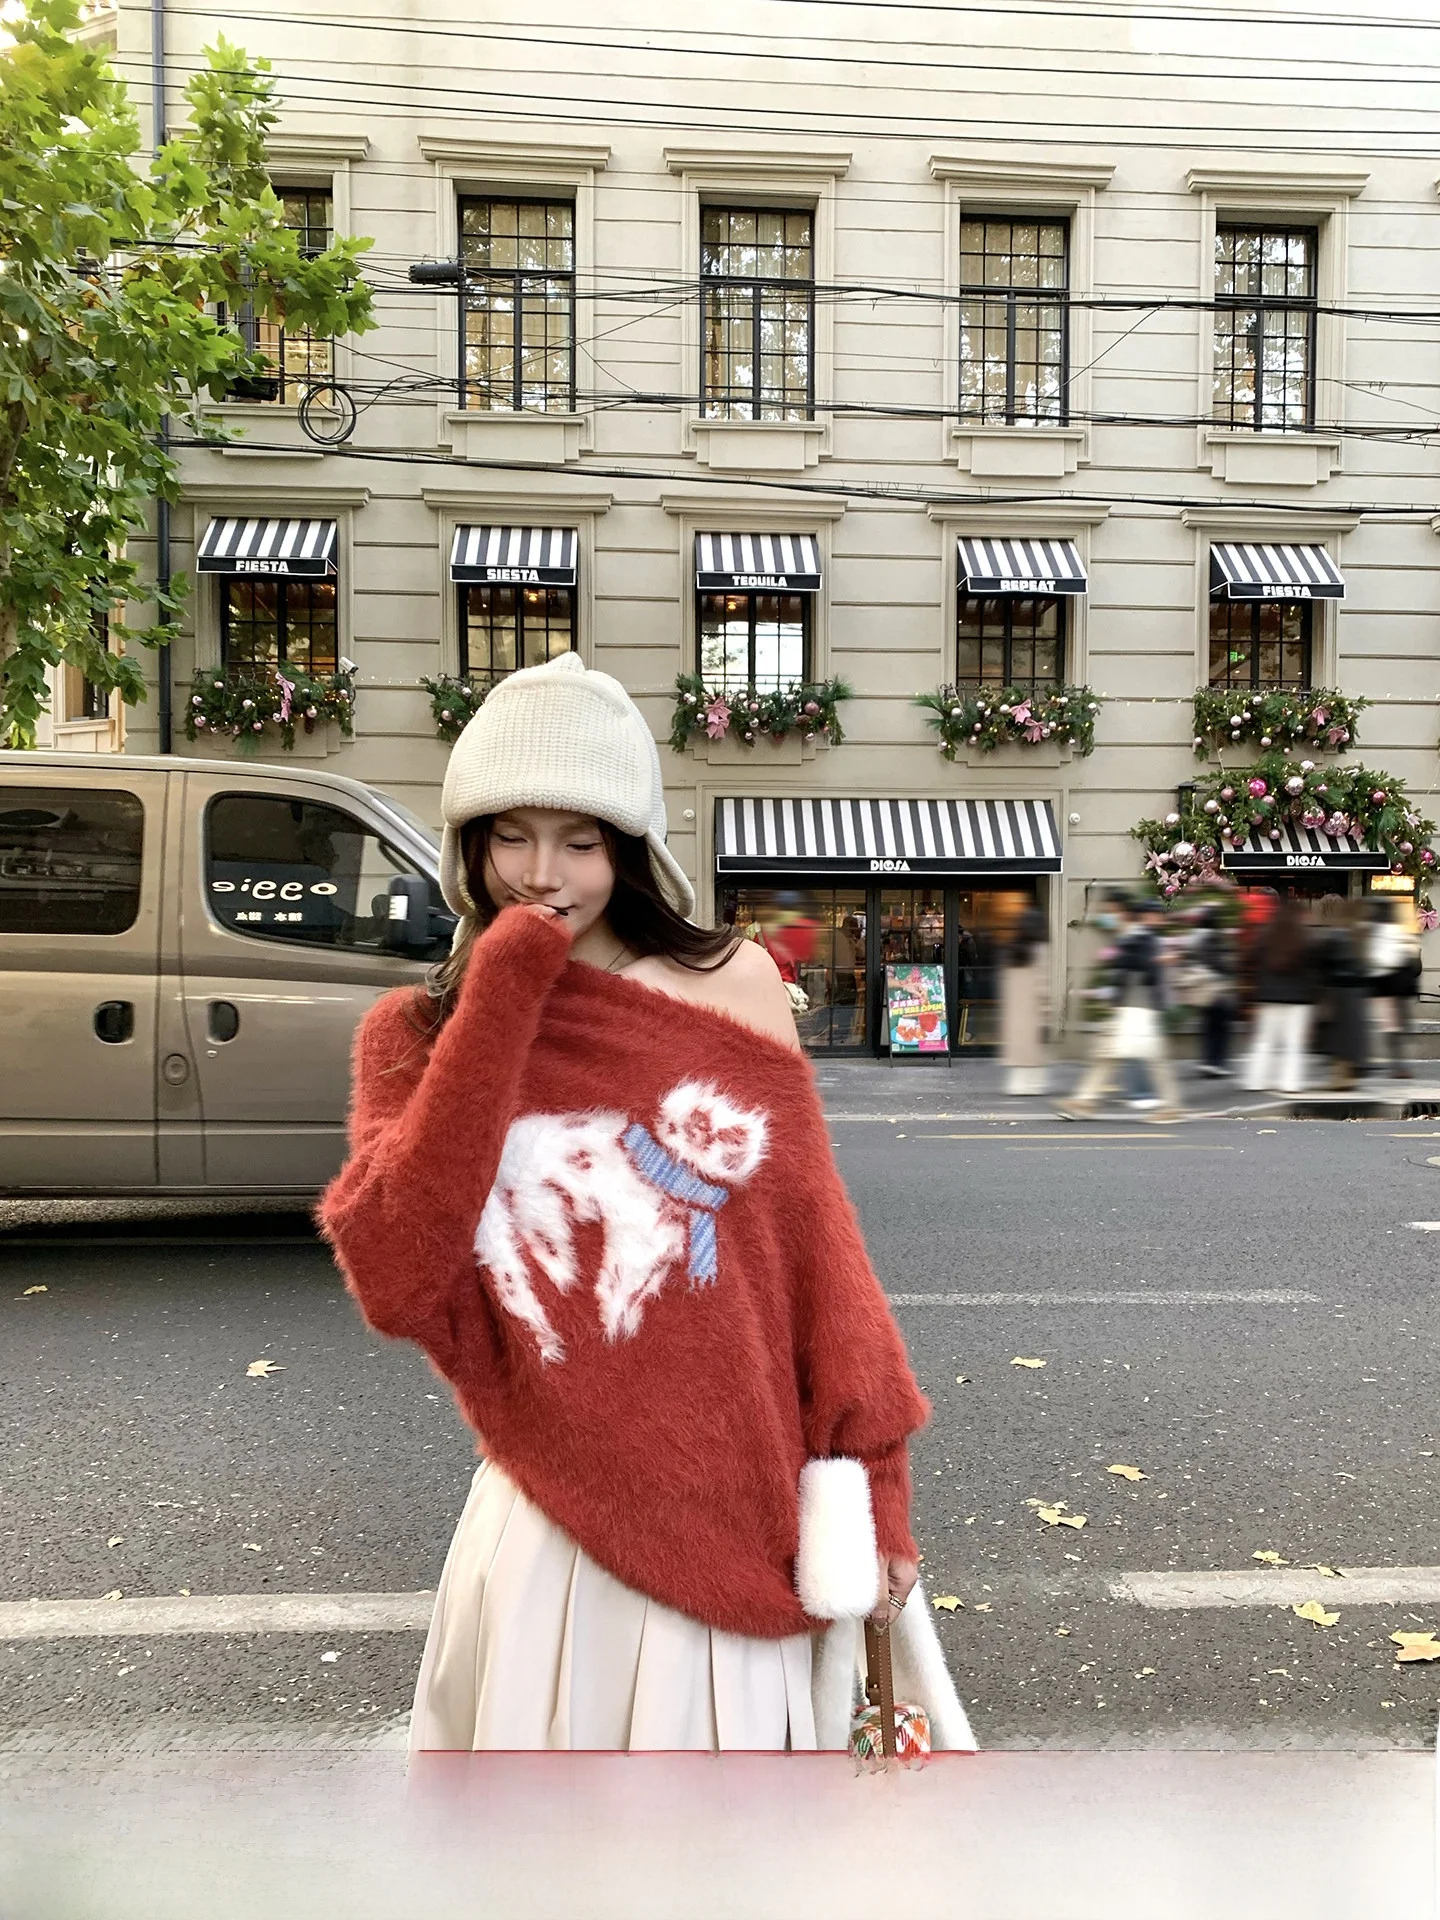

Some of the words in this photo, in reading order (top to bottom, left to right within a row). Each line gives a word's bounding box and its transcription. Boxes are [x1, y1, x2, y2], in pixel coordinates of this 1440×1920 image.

[235, 560, 289, 573] FIESTA
[486, 568, 540, 581] SIESTA
[731, 575, 788, 587] TEQUILA
[1000, 580, 1056, 592] REPEAT
[1262, 585, 1312, 597] FIESTA
[870, 859, 911, 871] DIOSA
[1286, 855, 1326, 866] DIOSA
